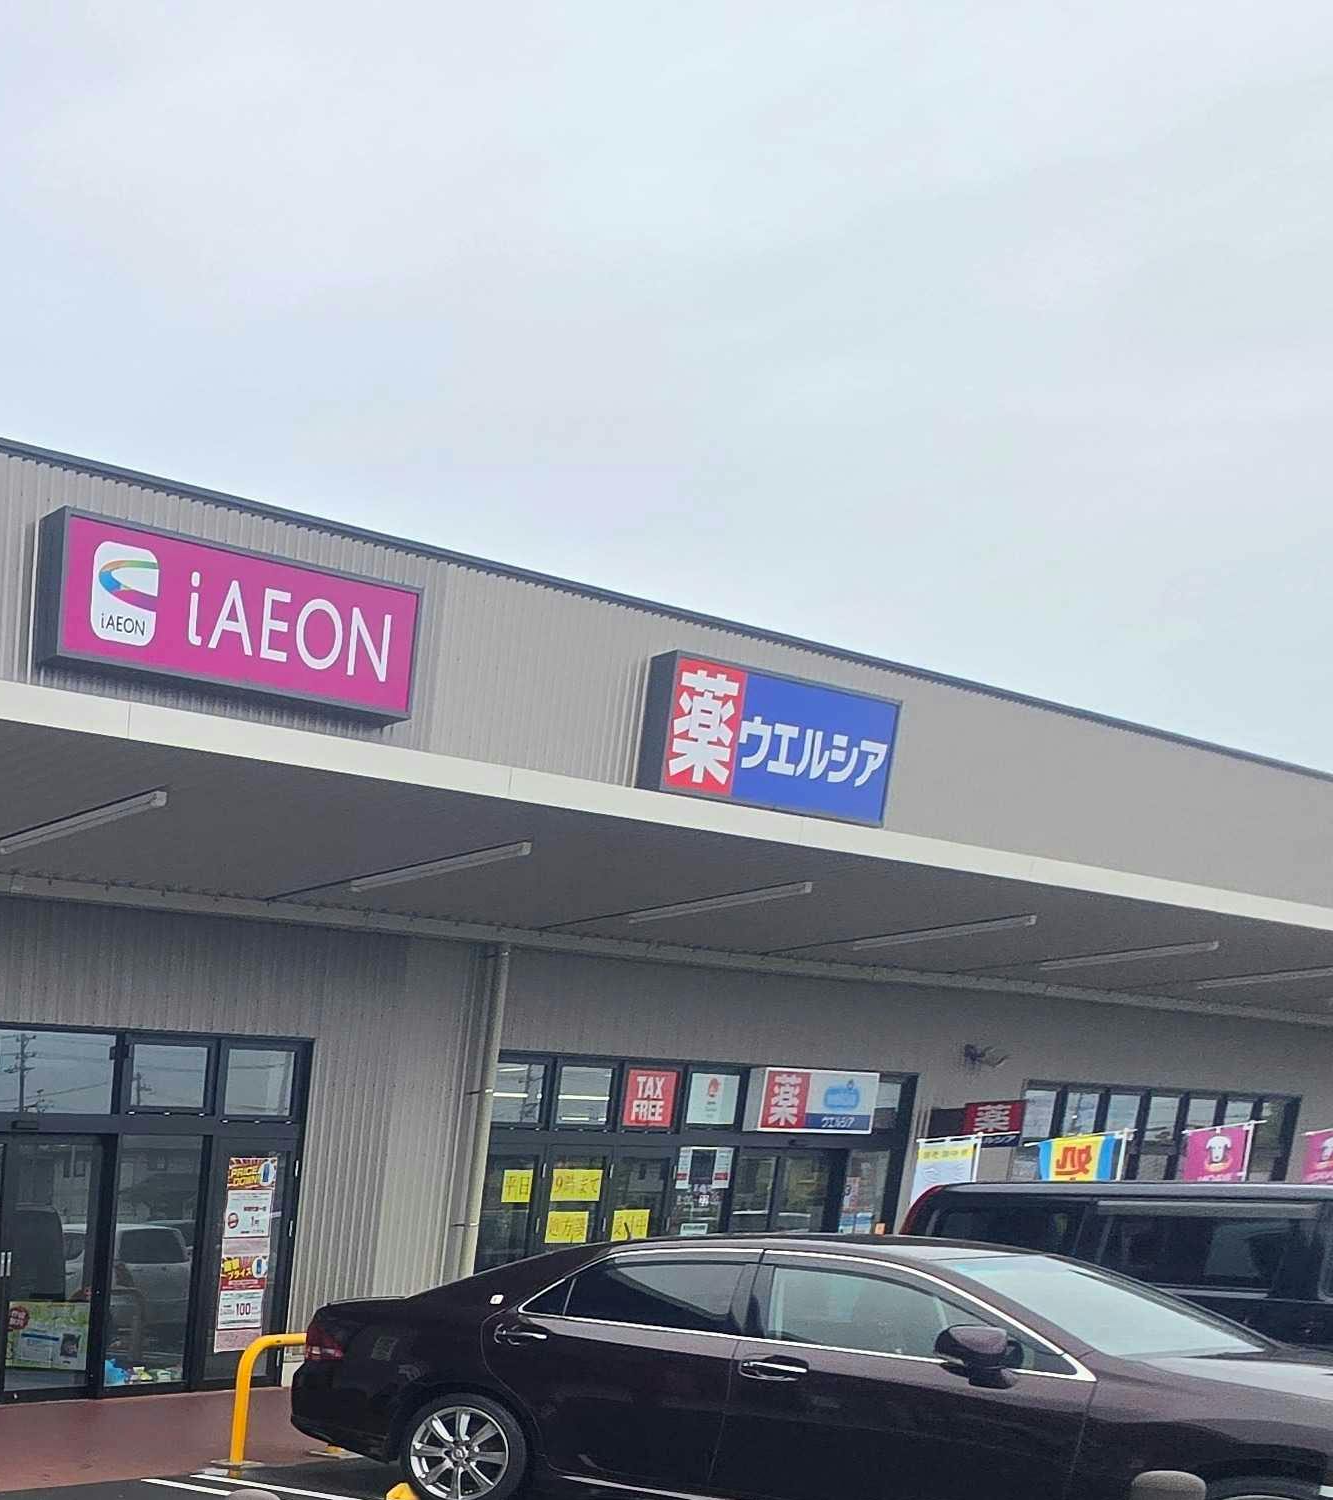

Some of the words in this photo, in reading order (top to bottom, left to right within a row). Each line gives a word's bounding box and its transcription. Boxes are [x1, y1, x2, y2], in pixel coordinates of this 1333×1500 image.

[100, 612, 146, 637] iAEON
[187, 571, 392, 683] iAEON
[668, 670, 739, 785] 薬
[738, 715, 888, 787] ウエルシア
[637, 1076, 665, 1099] TAX
[768, 1074, 803, 1126] 薬
[631, 1100, 665, 1121] FREE
[973, 1104, 1012, 1133] 薬
[230, 1165, 260, 1178] PRICE
[505, 1175, 531, 1197] 平日
